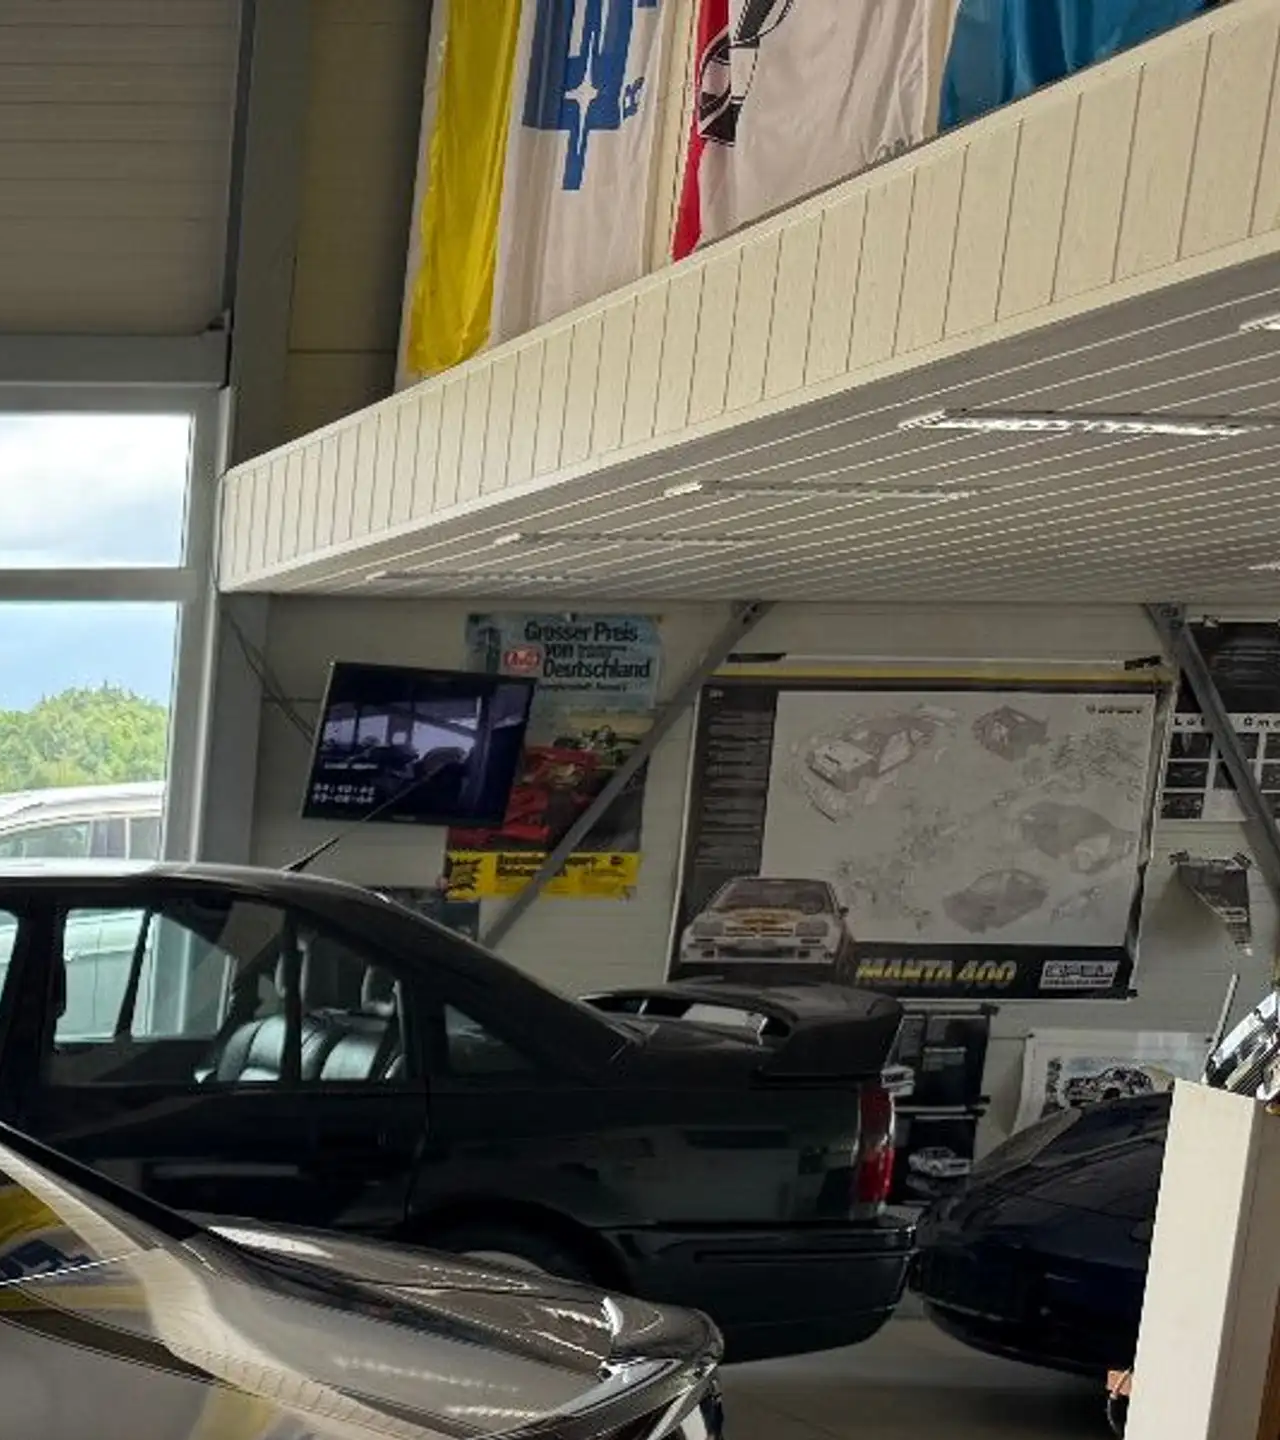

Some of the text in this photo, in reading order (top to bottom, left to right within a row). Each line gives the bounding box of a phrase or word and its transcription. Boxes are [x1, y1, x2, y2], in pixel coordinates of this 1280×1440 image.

[524, 620, 638, 642] Grosser Preis
[542, 656, 652, 678] Deutschland
[855, 957, 1018, 989] MANTA 400
